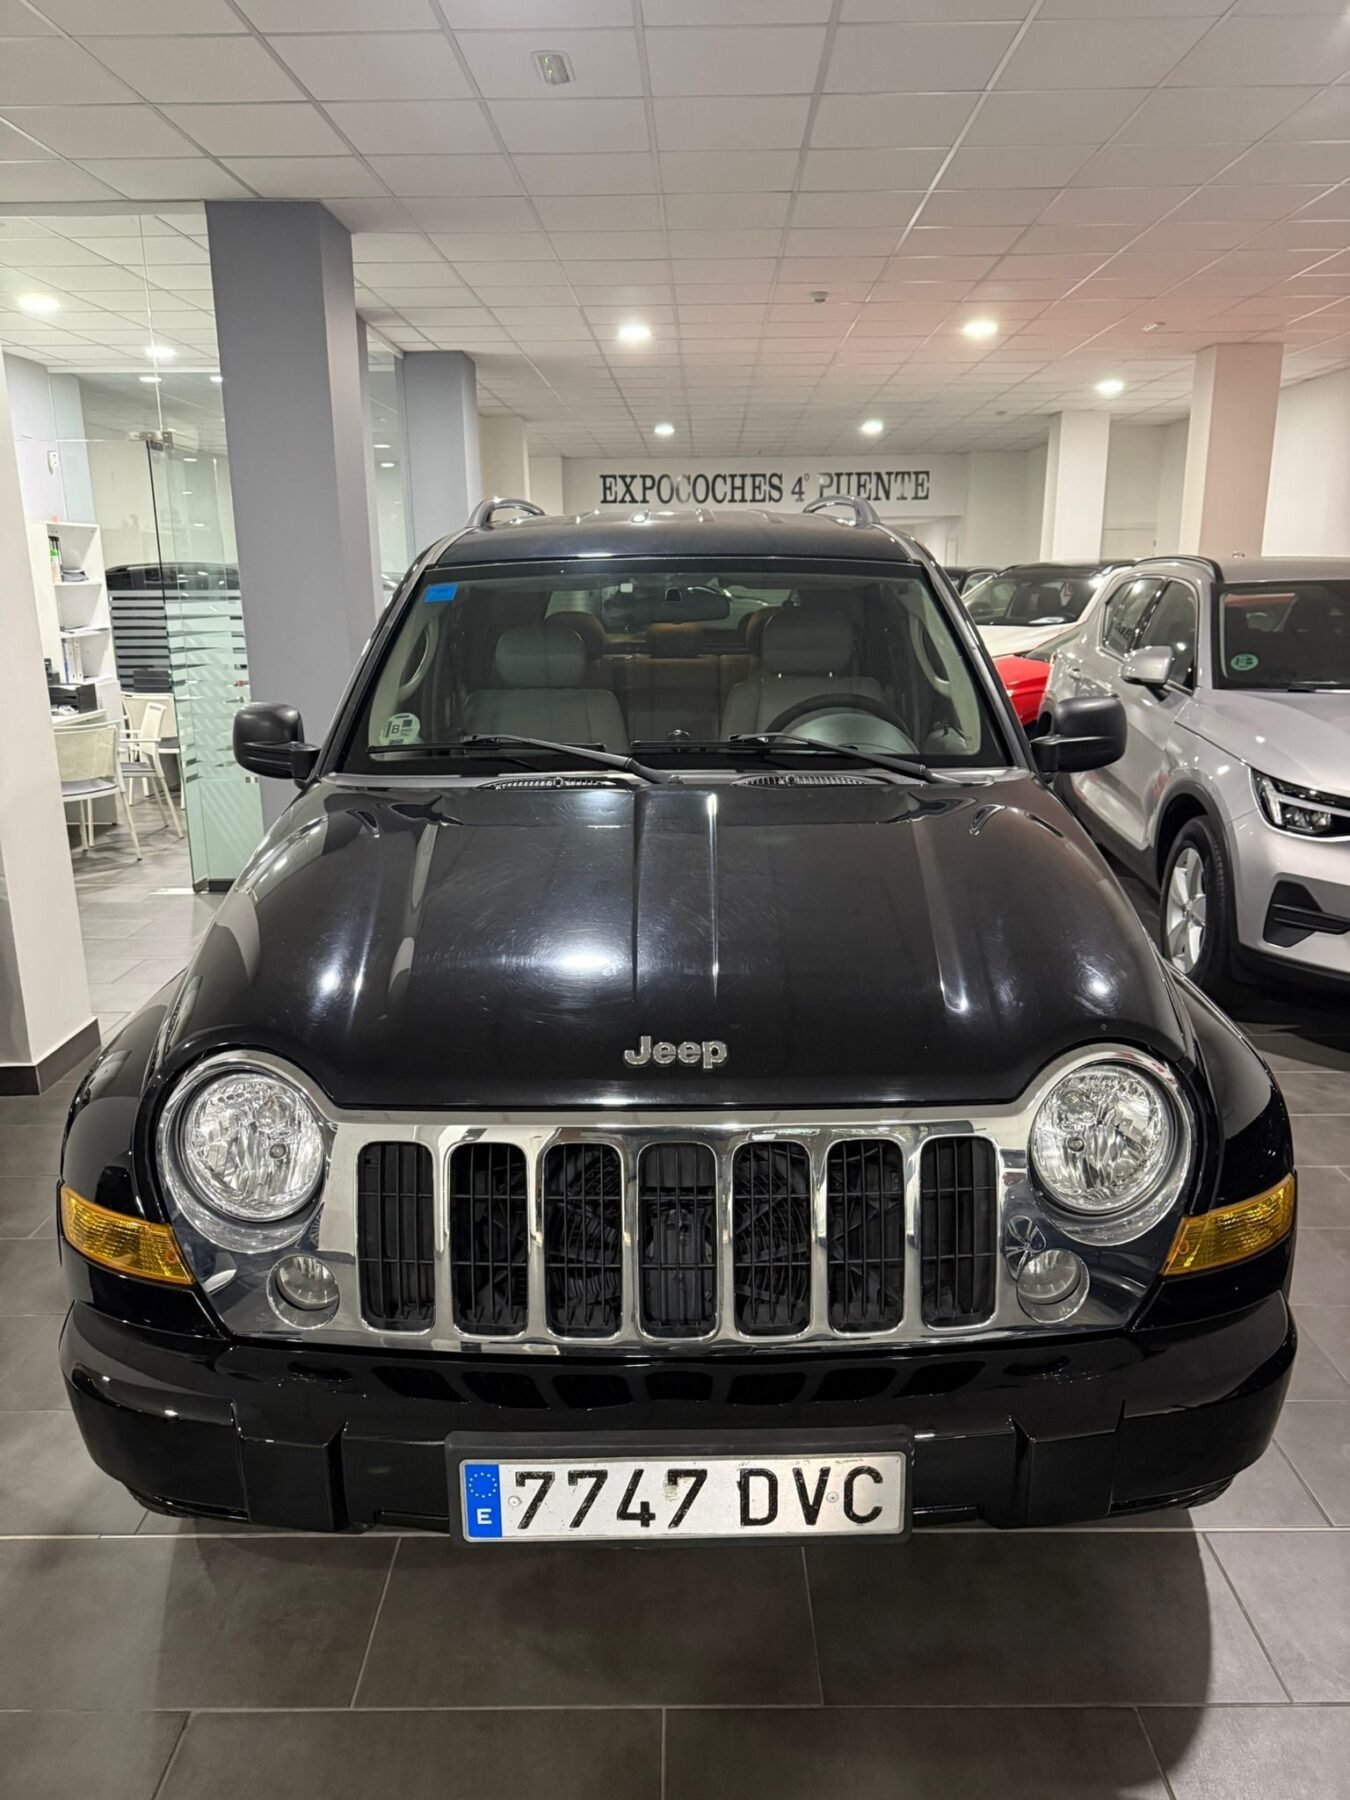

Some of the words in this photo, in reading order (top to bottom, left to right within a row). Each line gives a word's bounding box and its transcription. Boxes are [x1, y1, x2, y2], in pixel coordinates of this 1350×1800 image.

[600, 473, 784, 504] EXPOCOCHES
[817, 470, 930, 501] PUENTE
[624, 1035, 728, 1069] Jeep
[477, 1508, 493, 1525] E
[515, 1468, 708, 1530] 7747
[737, 1465, 884, 1526] DVC
